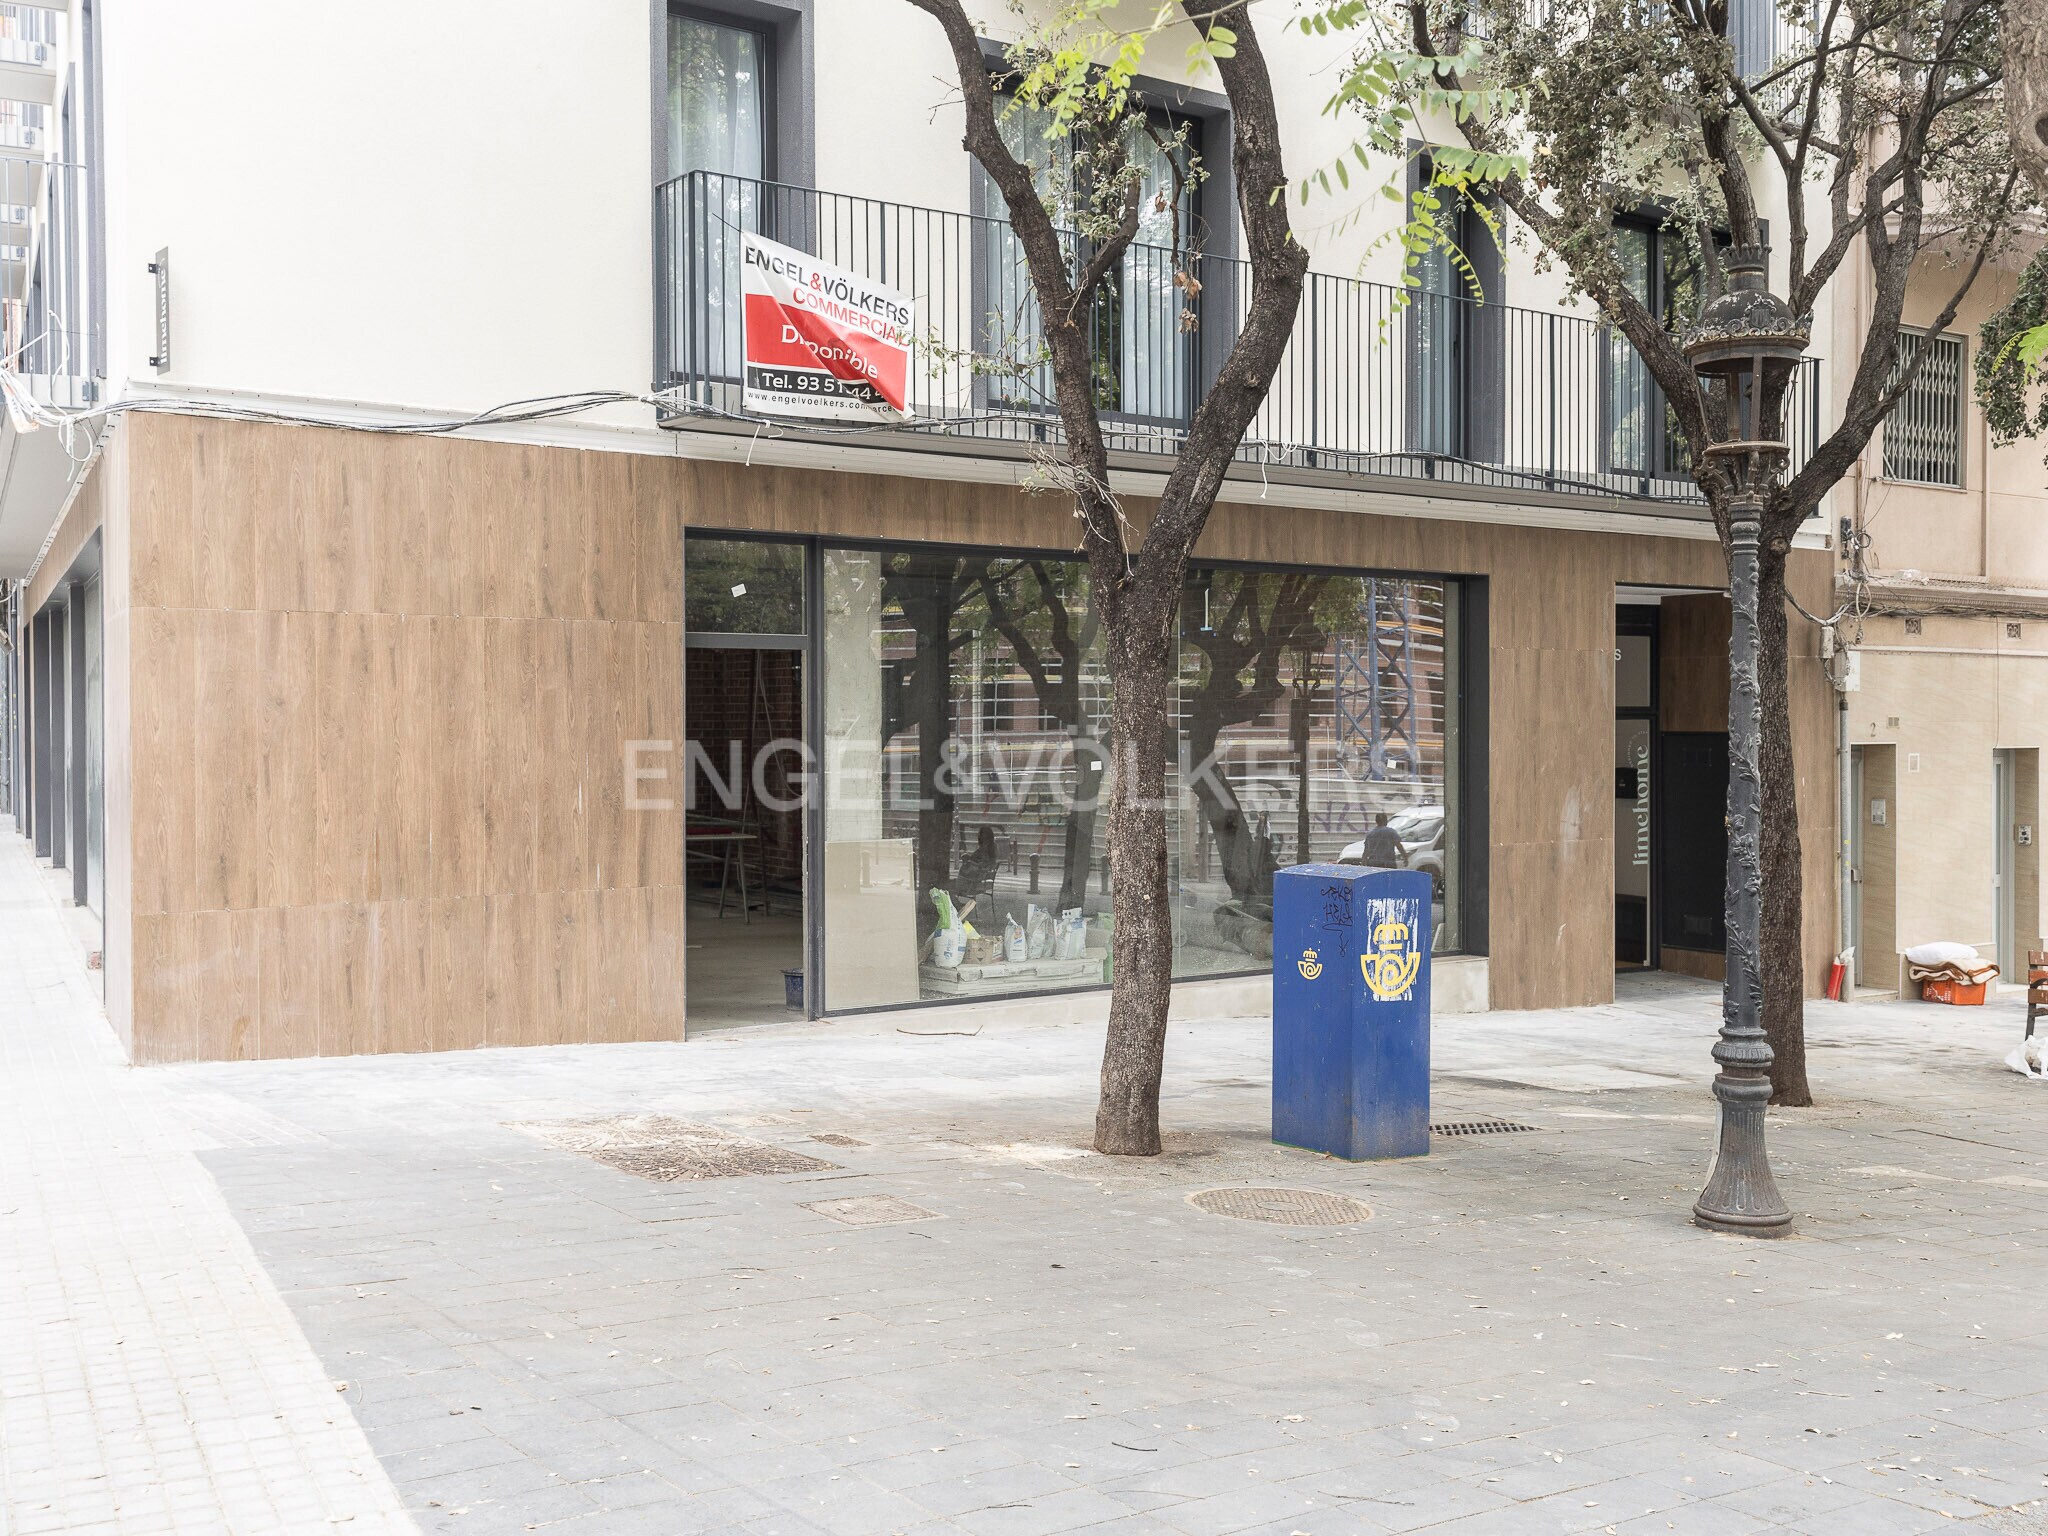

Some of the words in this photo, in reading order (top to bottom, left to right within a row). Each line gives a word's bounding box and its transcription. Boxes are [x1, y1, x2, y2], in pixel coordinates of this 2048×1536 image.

[745, 245, 909, 326] ENGEL&VÖLKERS
[781, 324, 878, 379] Diponible
[761, 372, 793, 389] Tel.
[797, 375, 820, 392] 93
[823, 378, 852, 395] 51
[1870, 722, 1877, 737] 2
[1632, 744, 1648, 866] limehome
